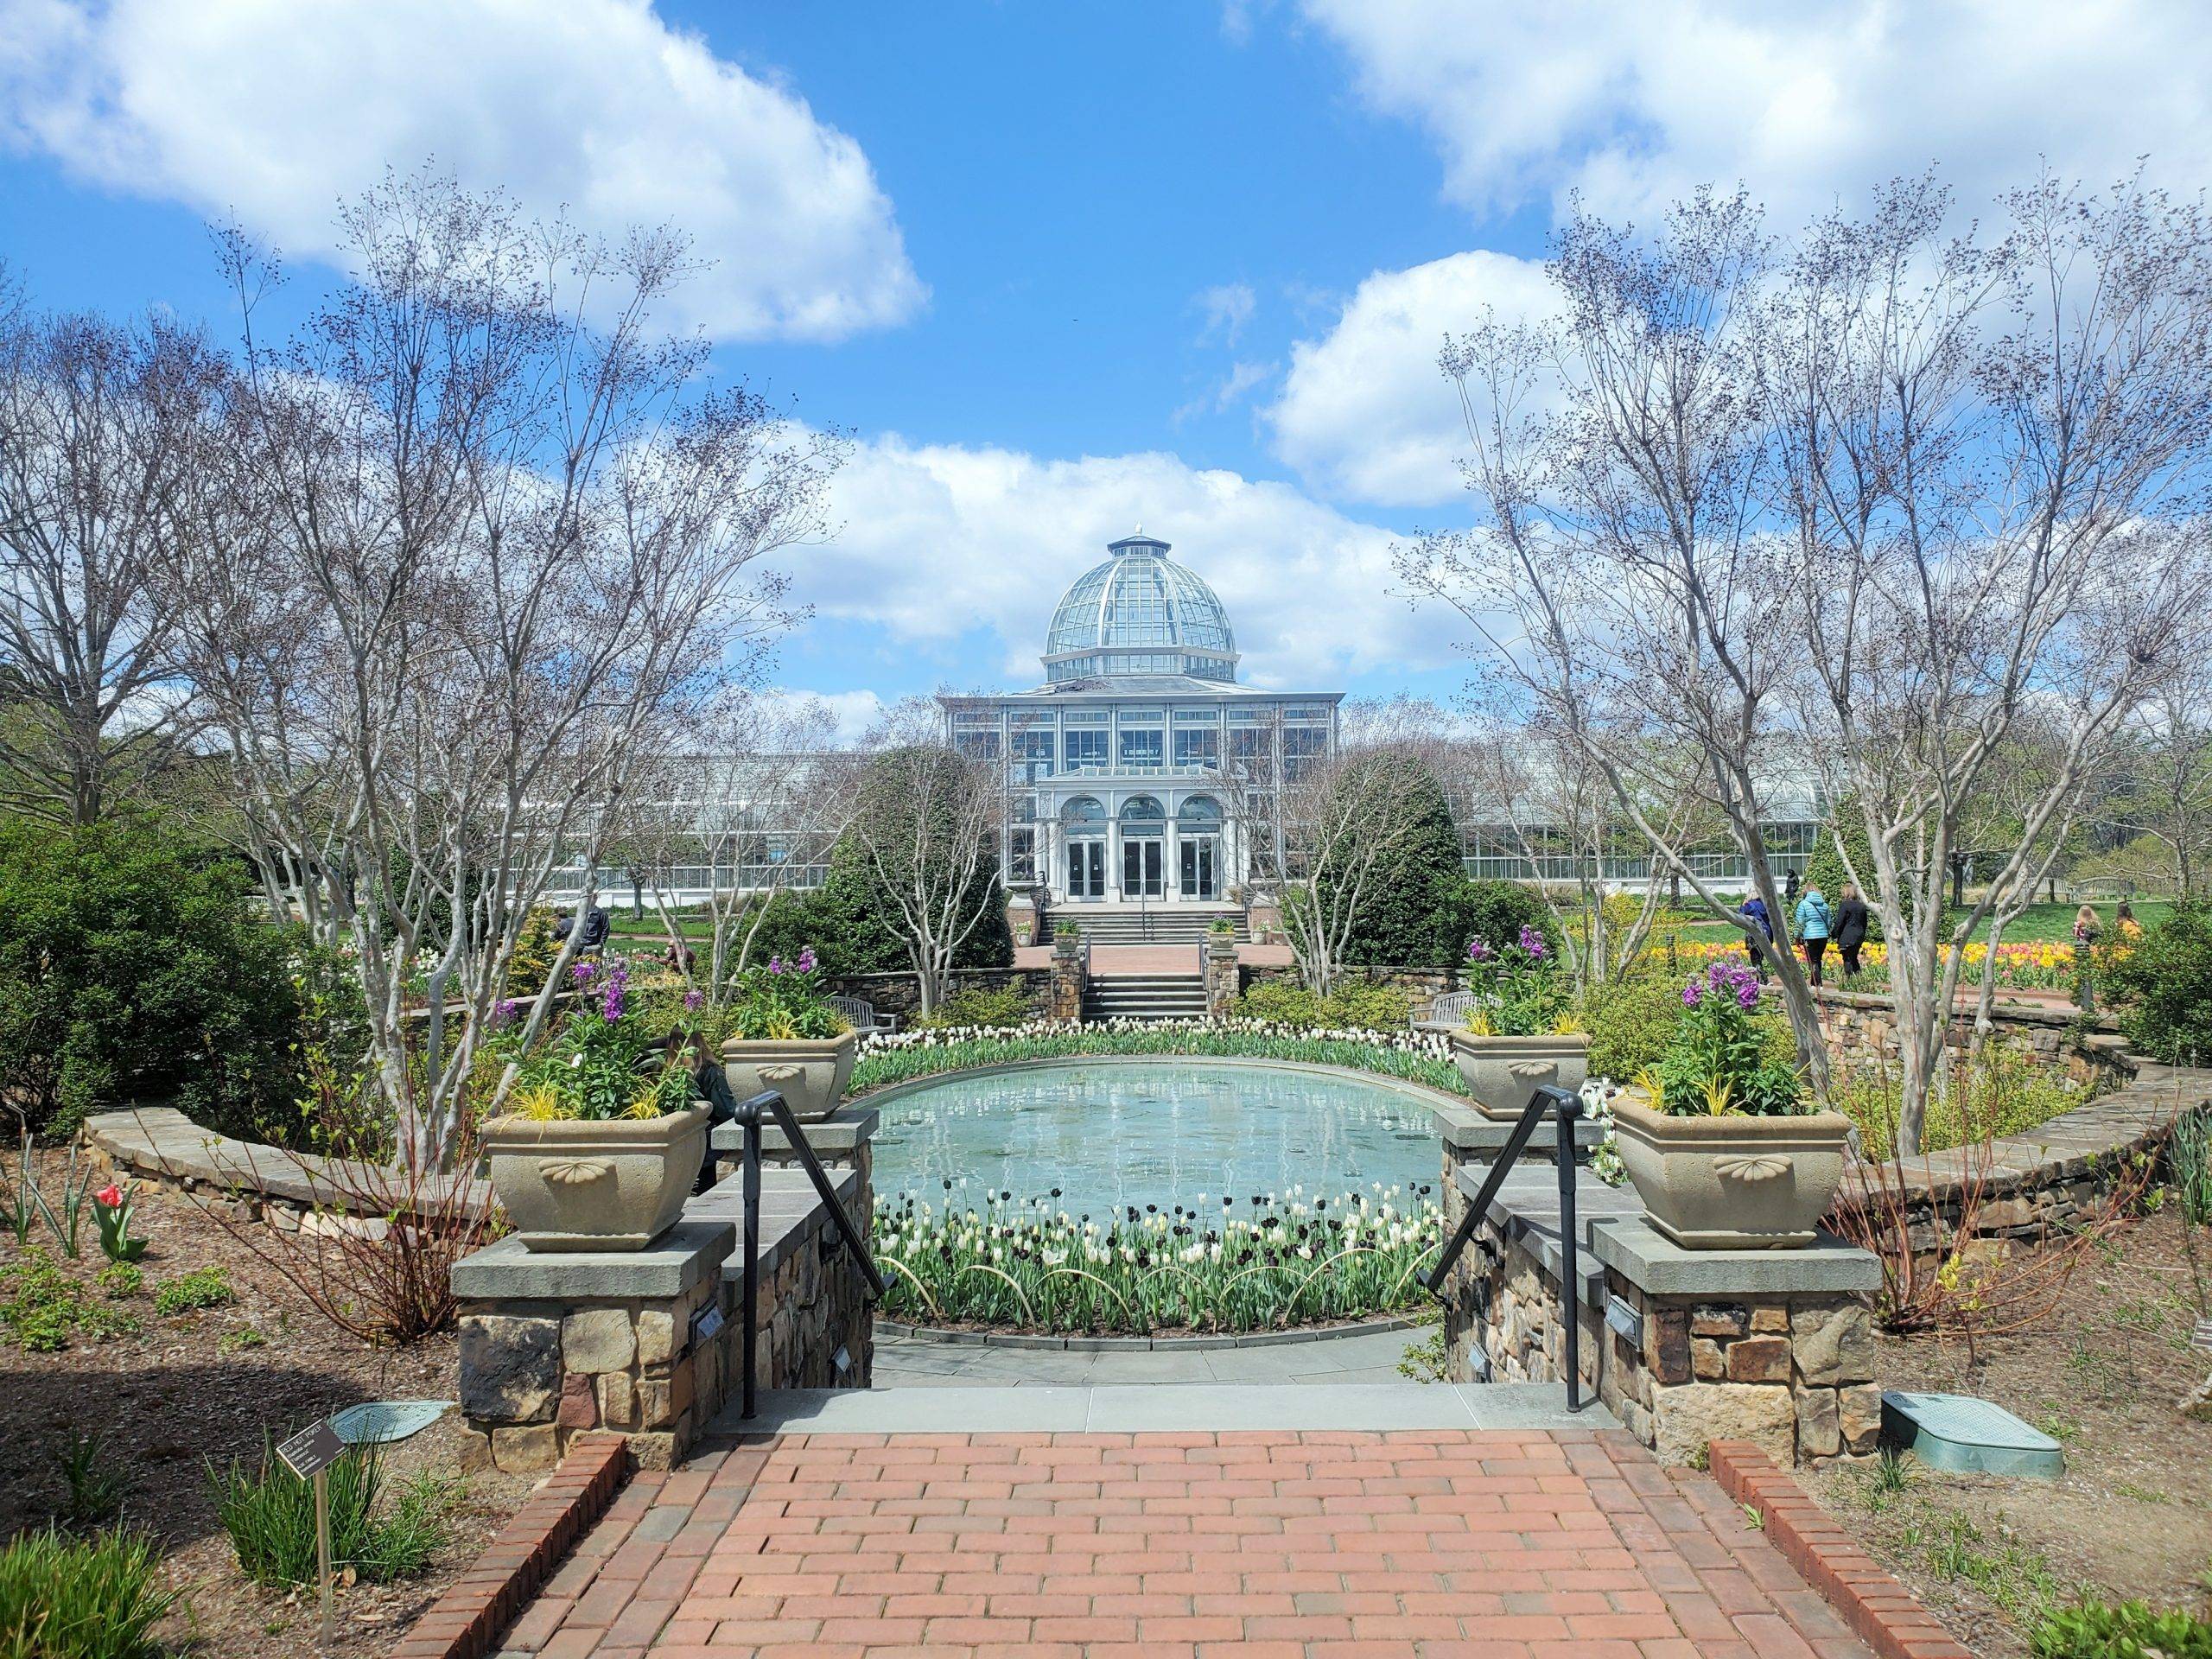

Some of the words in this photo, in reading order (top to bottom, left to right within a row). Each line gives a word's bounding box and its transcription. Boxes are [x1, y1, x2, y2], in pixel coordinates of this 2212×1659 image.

[281, 1444, 293, 1453] RED
[294, 1437, 304, 1446] HOT
[305, 1425, 322, 1438] POKER
